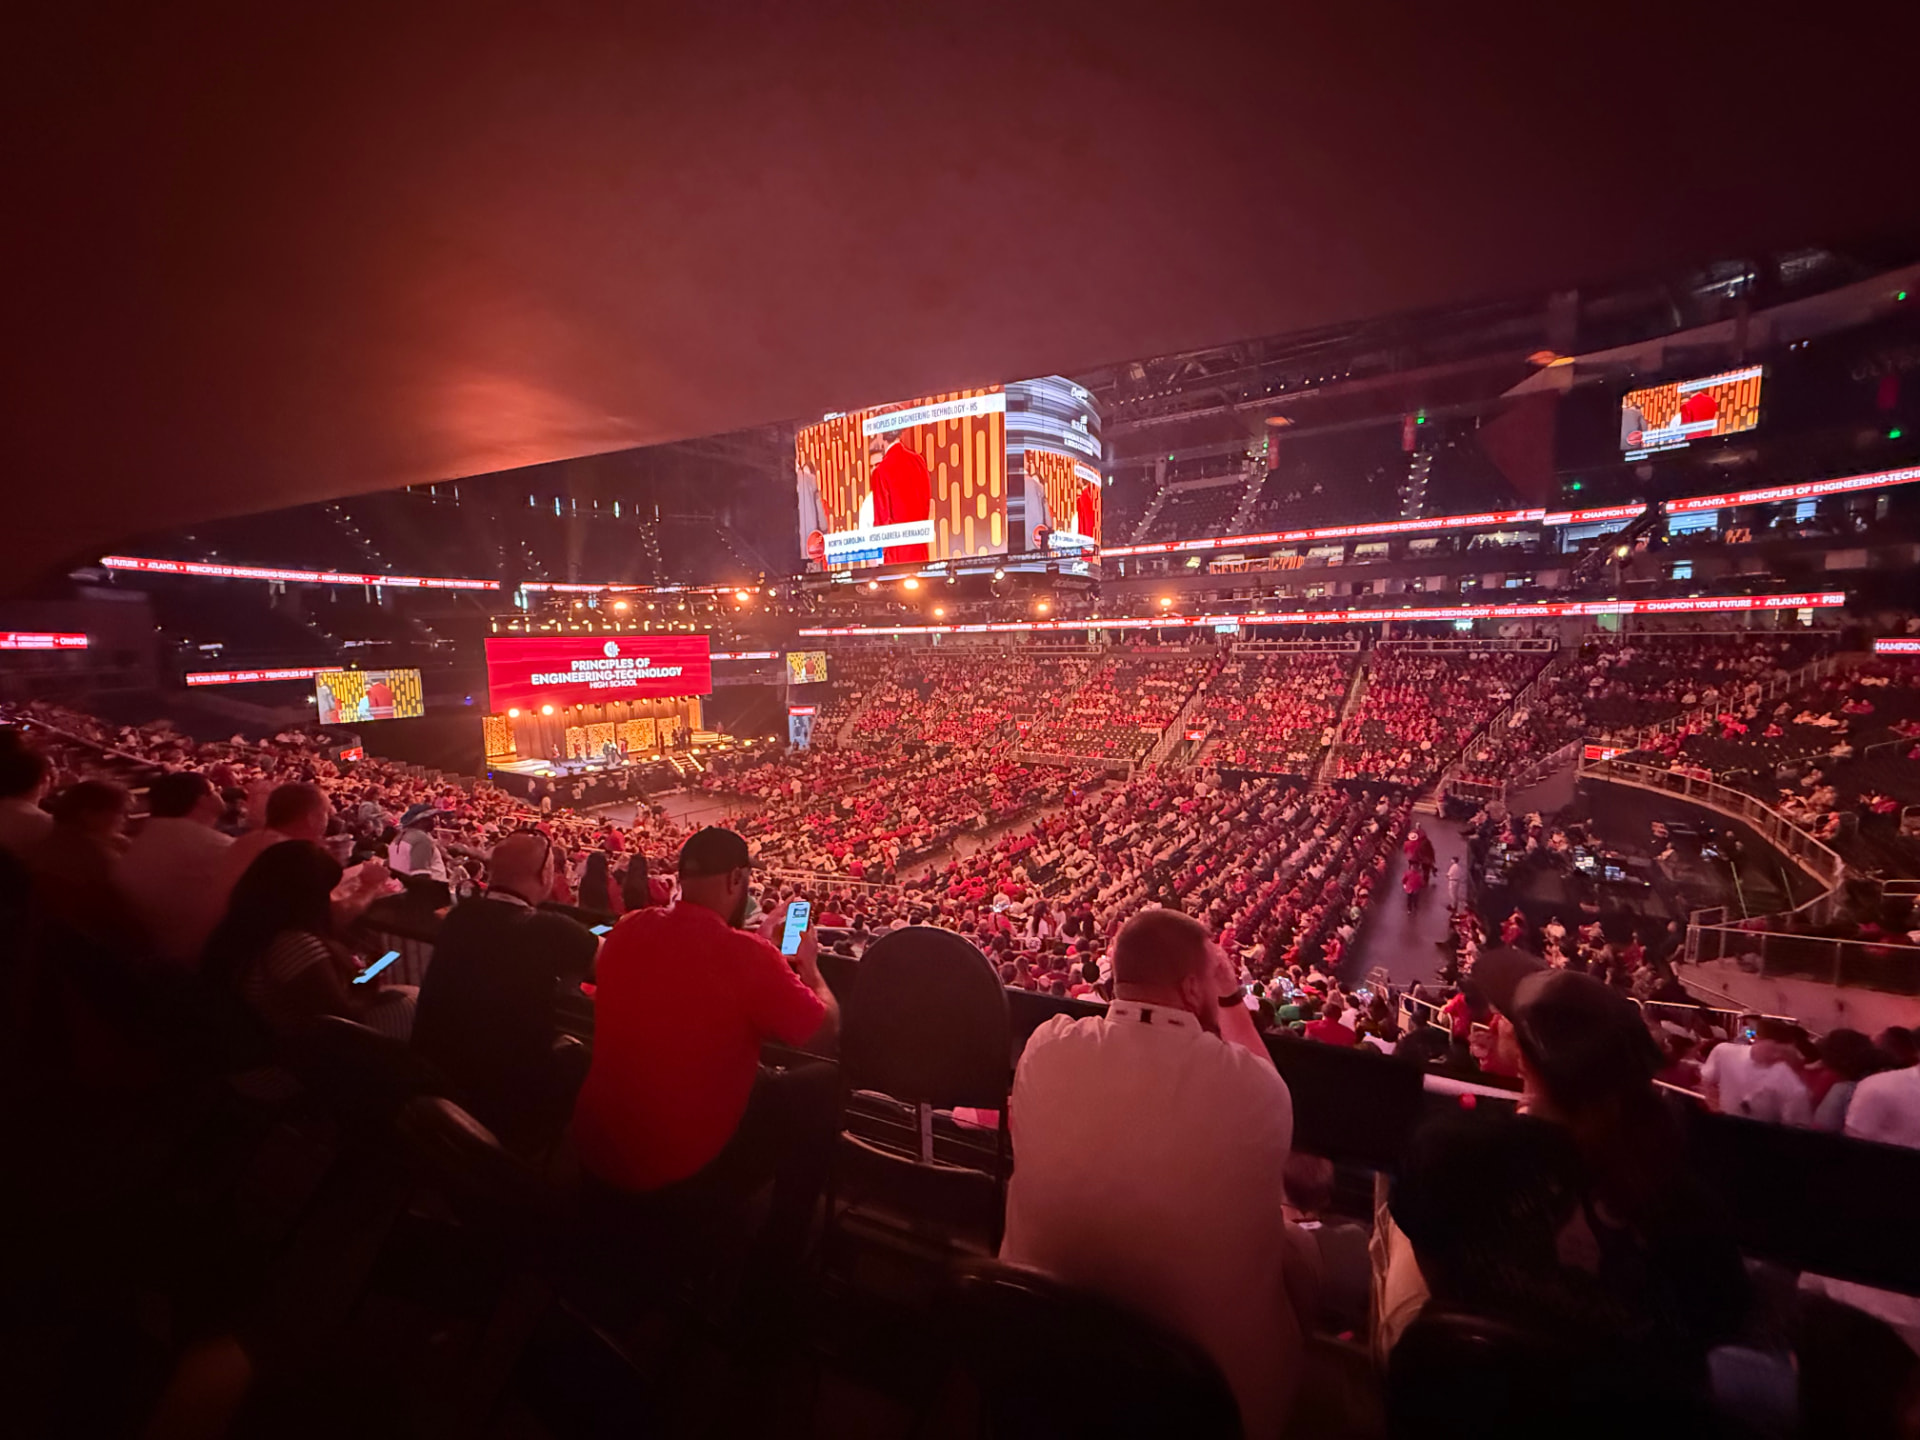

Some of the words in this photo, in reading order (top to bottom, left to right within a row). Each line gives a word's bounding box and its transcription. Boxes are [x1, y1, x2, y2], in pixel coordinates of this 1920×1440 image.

[890, 415, 897, 427] OF
[897, 409, 931, 426] ENGINEERING
[931, 403, 965, 419] TECHNOLOGY
[970, 401, 978, 412] HS
[1687, 498, 1727, 509] ATLANTA
[1739, 488, 1795, 502] PRINCIPLES
[1796, 486, 1811, 496] OF
[1582, 509, 1624, 520] CHAMPION
[1314, 528, 1347, 538] PRINCIPLES
[1347, 527, 1356, 535] OF
[1446, 517, 1466, 526] HIGH
[1466, 515, 1496, 524] SCHOOL
[828, 539, 843, 548] NORTH
[843, 535, 866, 547] CAROLINA
[881, 529, 901, 541] CABRERA
[902, 526, 931, 539] HERNANDEZ
[113, 558, 138, 569] FUTURE
[148, 562, 178, 572] ATLANTA
[186, 565, 223, 576] PRINCIPLES
[222, 568, 233, 577] OF
[321, 574, 338, 582] HIGH
[339, 575, 365, 584] SCHOOL
[1647, 601, 1694, 612] CHAMPION
[1696, 600, 1718, 610] YOUR
[1719, 599, 1752, 609] FUTURE
[1765, 597, 1809, 607] ATLANTA
[1314, 613, 1340, 621] ATLANTA
[1347, 611, 1383, 620] PRINCIPLES
[1383, 611, 1393, 619] OF
[1494, 607, 1515, 616] HIGH
[1516, 606, 1549, 615] SCHOOL
[571, 658, 634, 672] PRINCIPLES
[635, 657, 651, 669] OF
[236, 672, 259, 681] ATLANTA
[265, 670, 299, 680] PRINCIPLES
[299, 670, 308, 678] OF
[531, 666, 683, 686] ENGINEERING-TECHNOLOGY
[610, 679, 638, 688] SCHOOL
